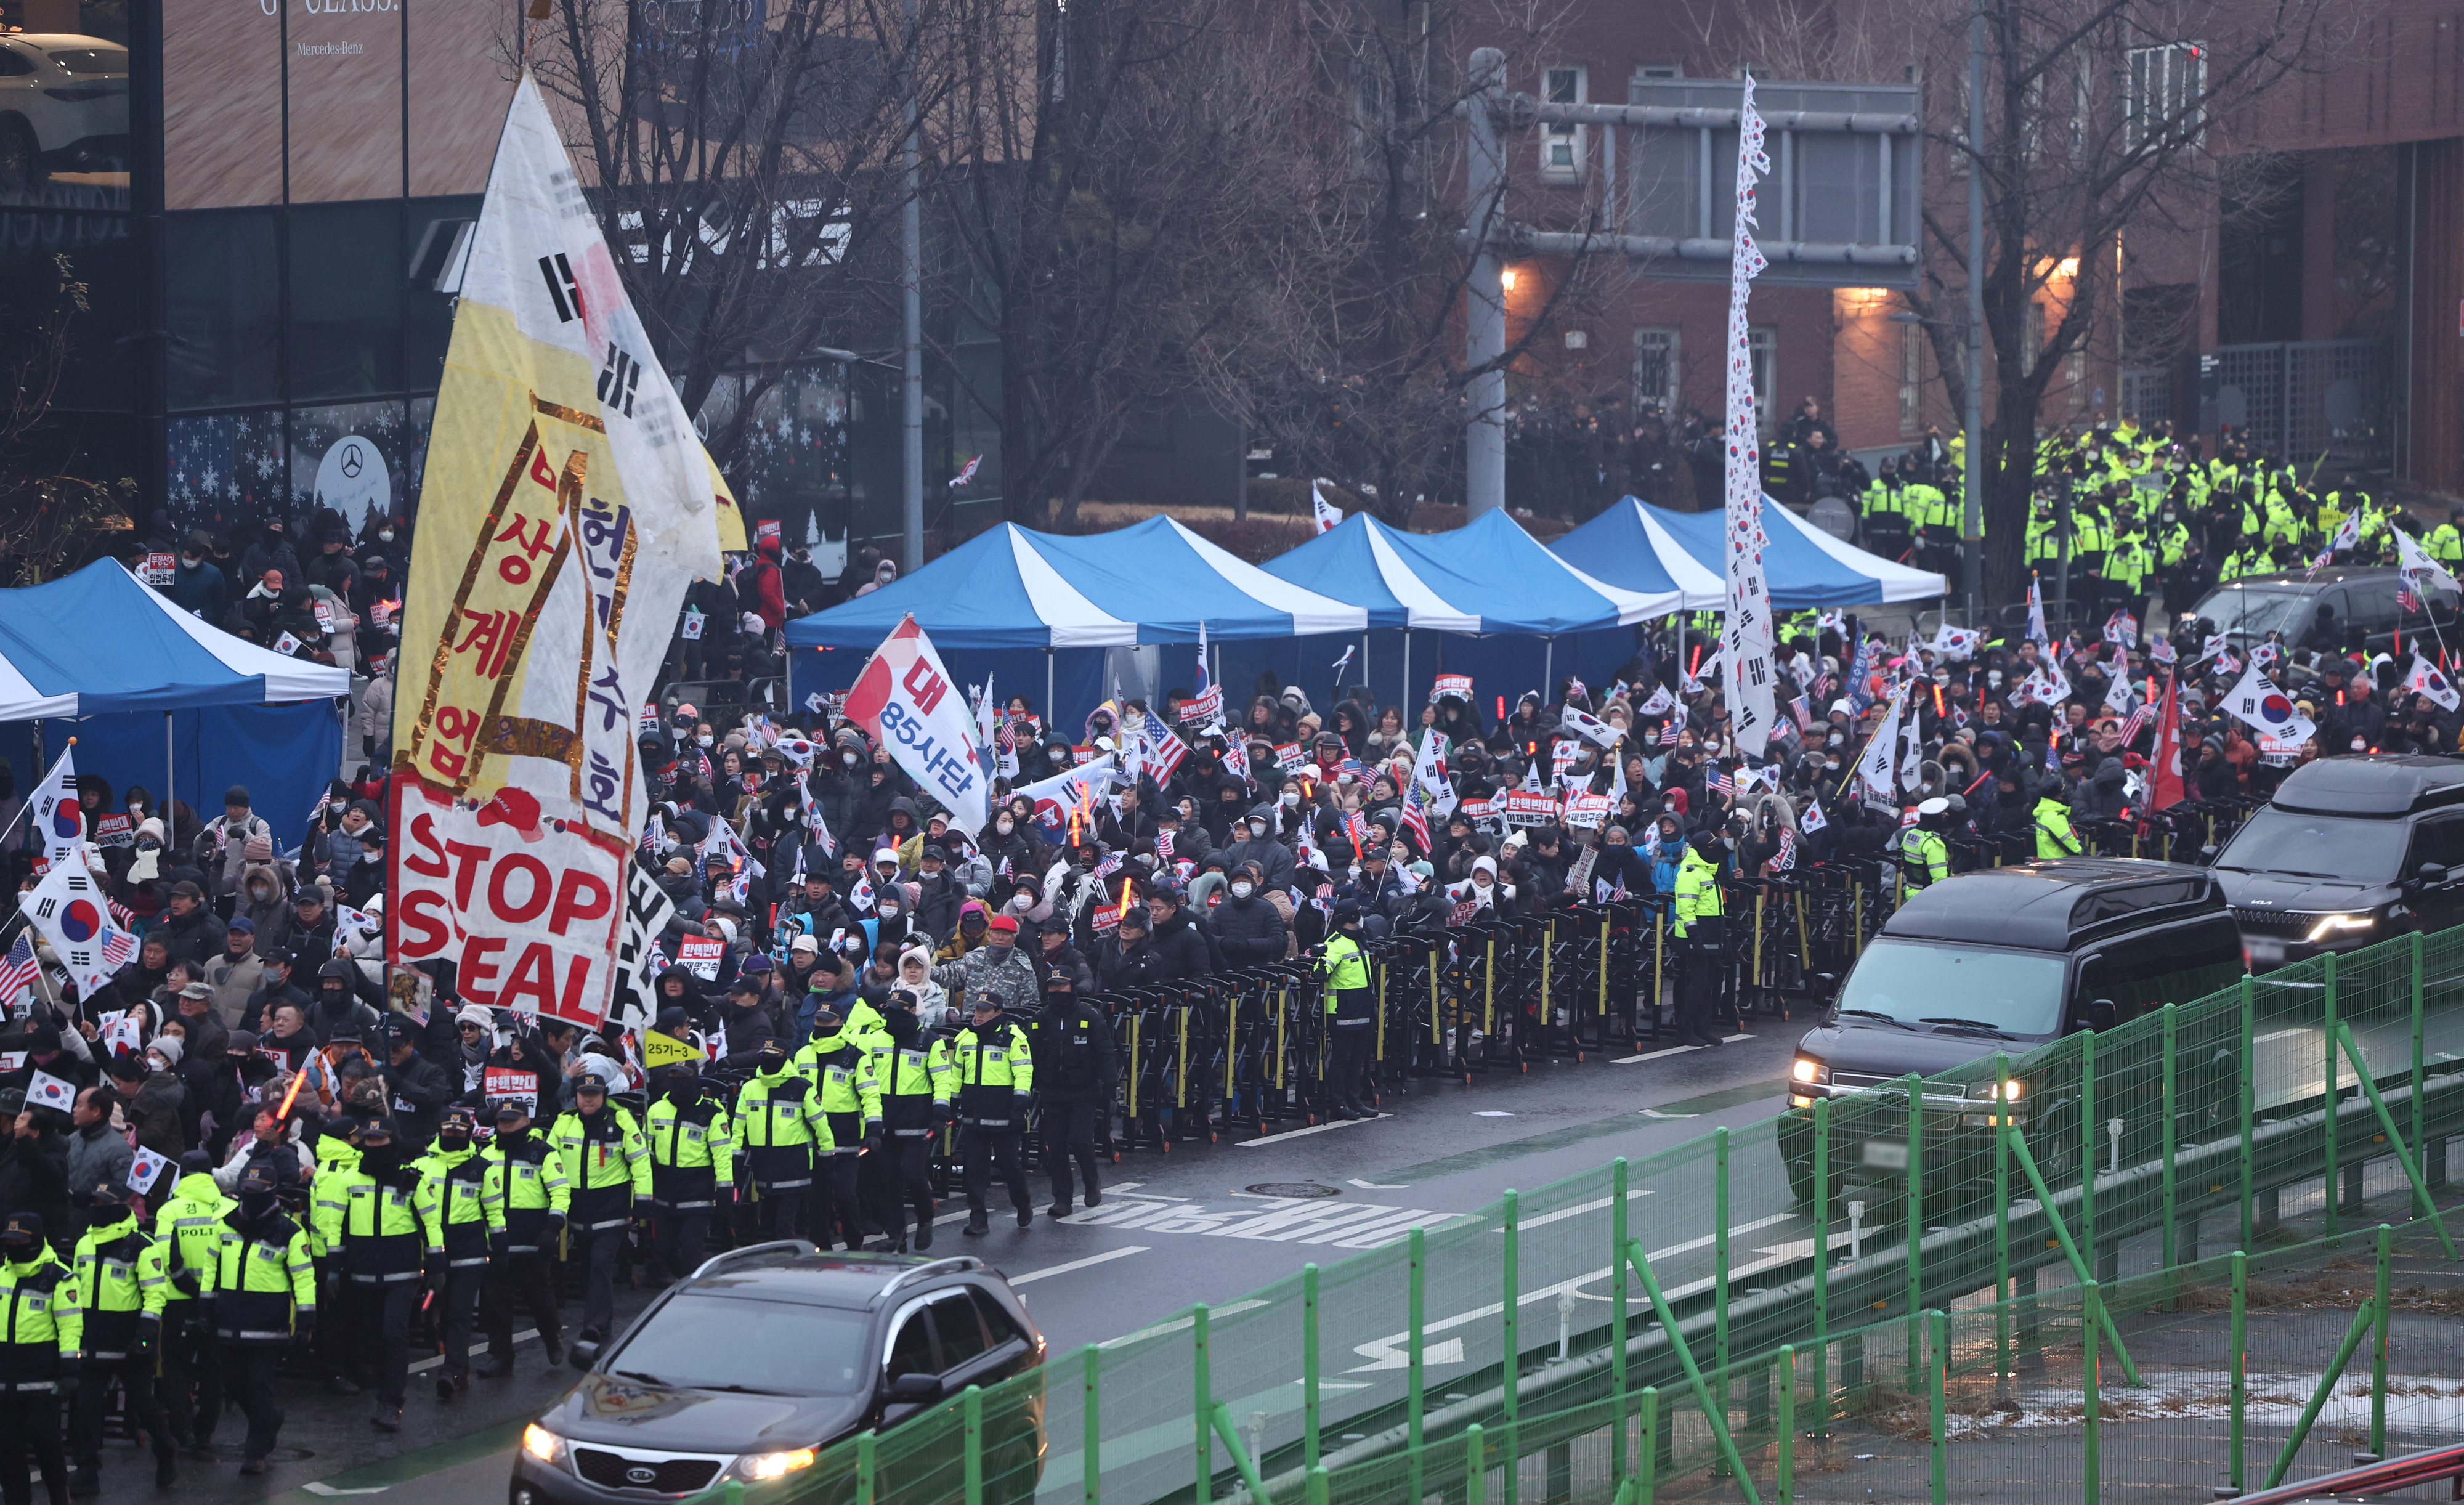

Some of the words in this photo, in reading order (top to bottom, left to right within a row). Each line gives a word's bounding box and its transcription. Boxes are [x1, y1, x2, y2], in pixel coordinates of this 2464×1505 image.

[297, 41, 363, 56] Mercedes-Benz
[152, 556, 175, 566] 부정선거
[1435, 678, 1471, 689] 탄핵반대
[1180, 696, 1218, 718] 탄핵반대
[881, 702, 973, 800] 85사단
[493, 795, 511, 815] MAGA
[1509, 797, 1554, 812] 탄핵반대
[1581, 848, 1597, 864] STOP
[405, 813, 612, 937] STOP
[683, 943, 723, 957] 탄핵반대
[399, 889, 599, 1028] SEAL
[649, 1043, 689, 1058] 25기-3
[486, 1074, 537, 1092] 탄핵반대
